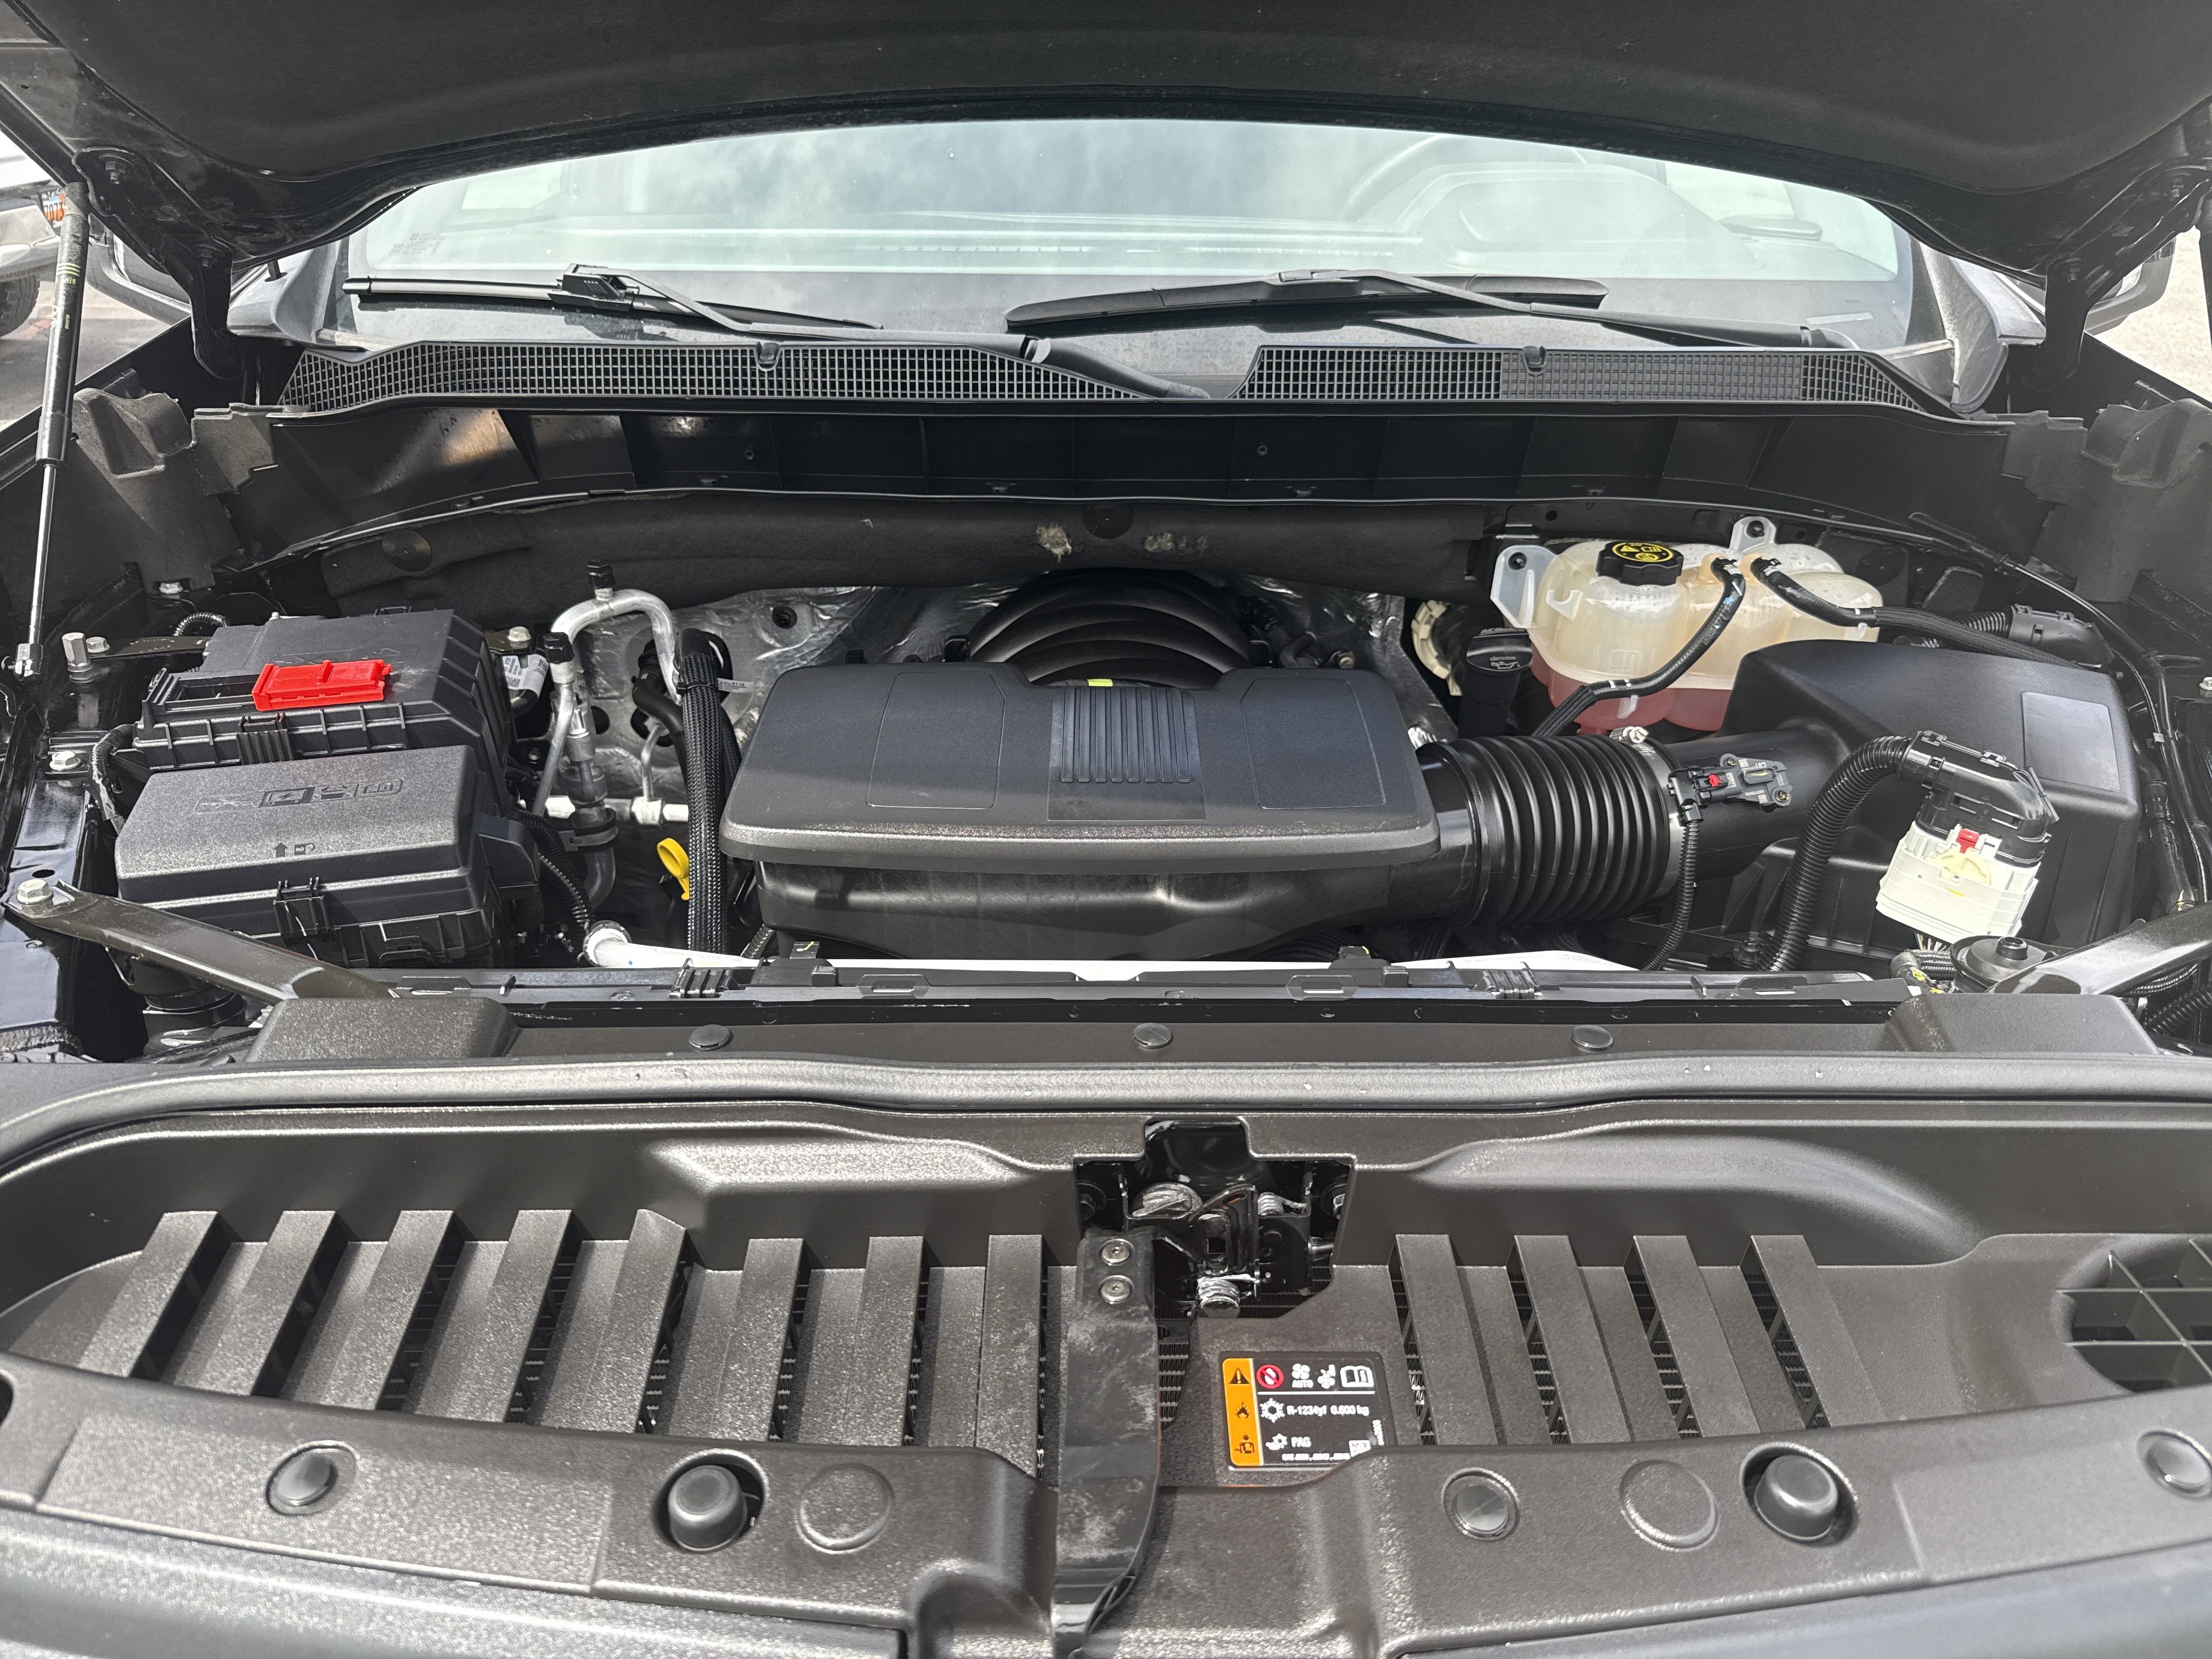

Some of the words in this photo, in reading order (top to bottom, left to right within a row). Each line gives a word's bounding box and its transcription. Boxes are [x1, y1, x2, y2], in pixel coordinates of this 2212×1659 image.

[1292, 1379, 1313, 1388] AUTO
[1356, 1404, 1369, 1416] kg
[1291, 1436, 1311, 1447] PAG
